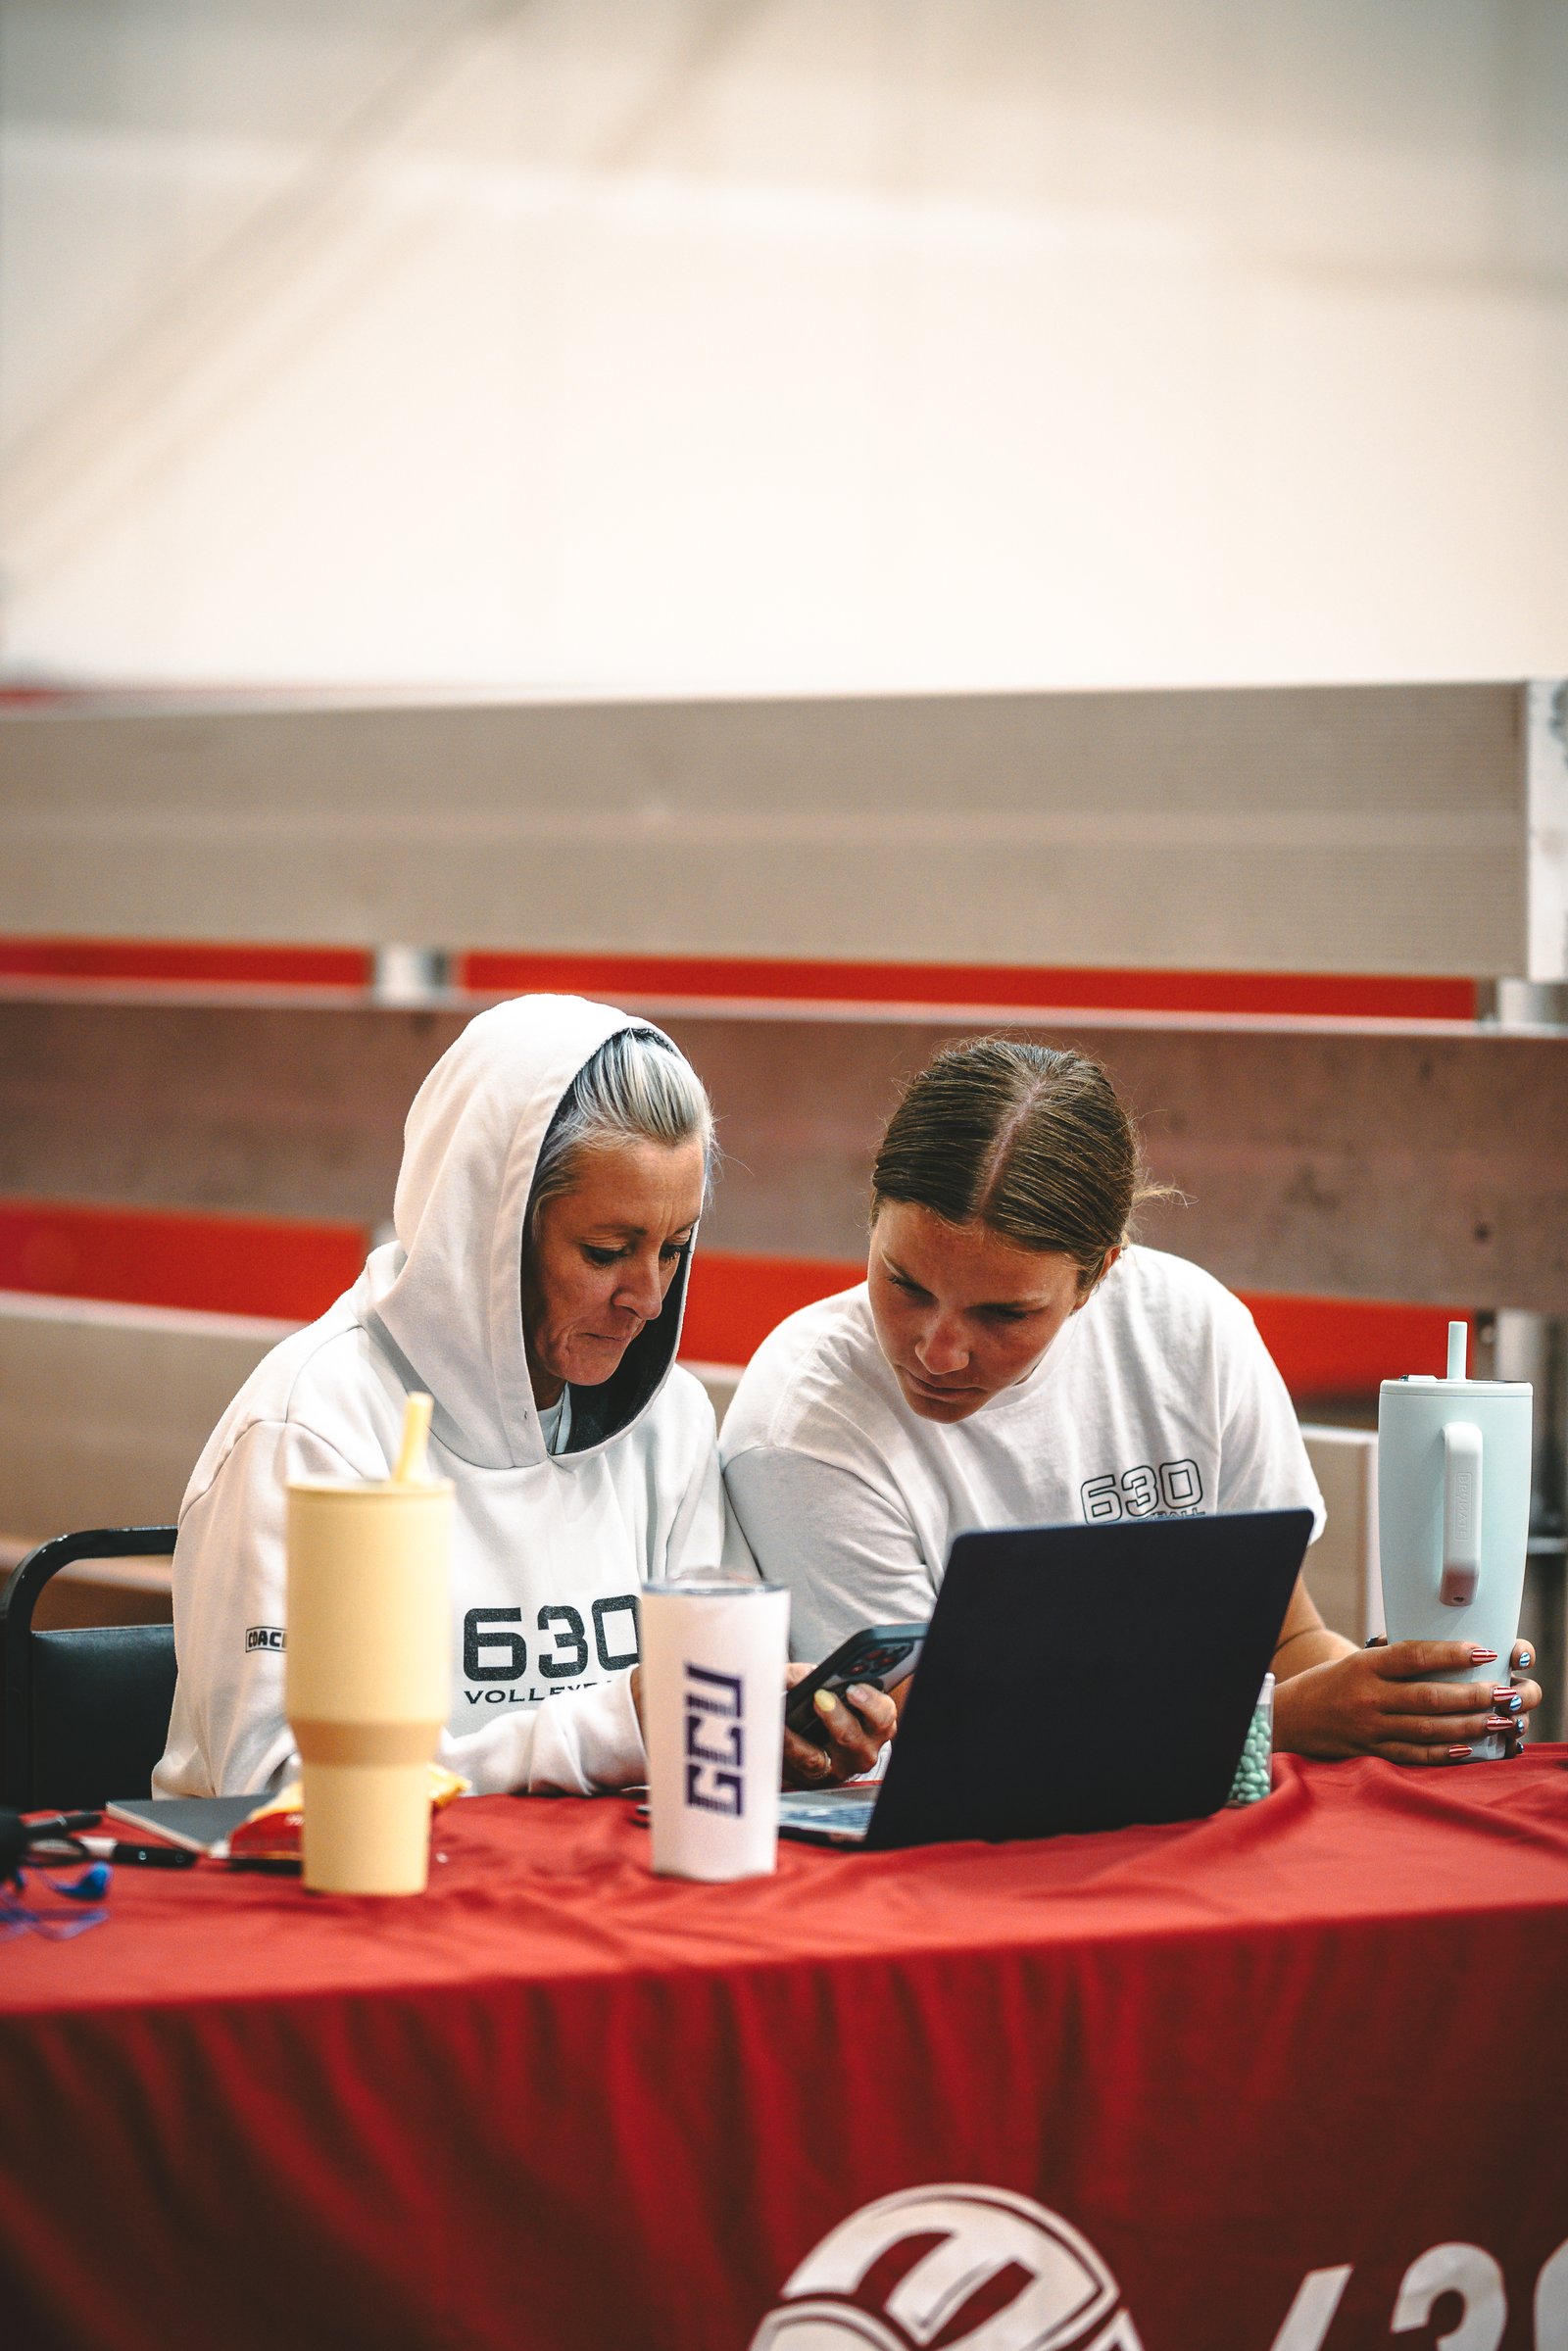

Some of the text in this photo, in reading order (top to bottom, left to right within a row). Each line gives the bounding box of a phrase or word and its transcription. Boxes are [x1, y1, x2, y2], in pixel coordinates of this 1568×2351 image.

[1080, 1458, 1203, 1525] 630
[463, 1593, 643, 1682] 630
[464, 1680, 612, 1704] VOLLE
[685, 1663, 742, 1817] GCU
